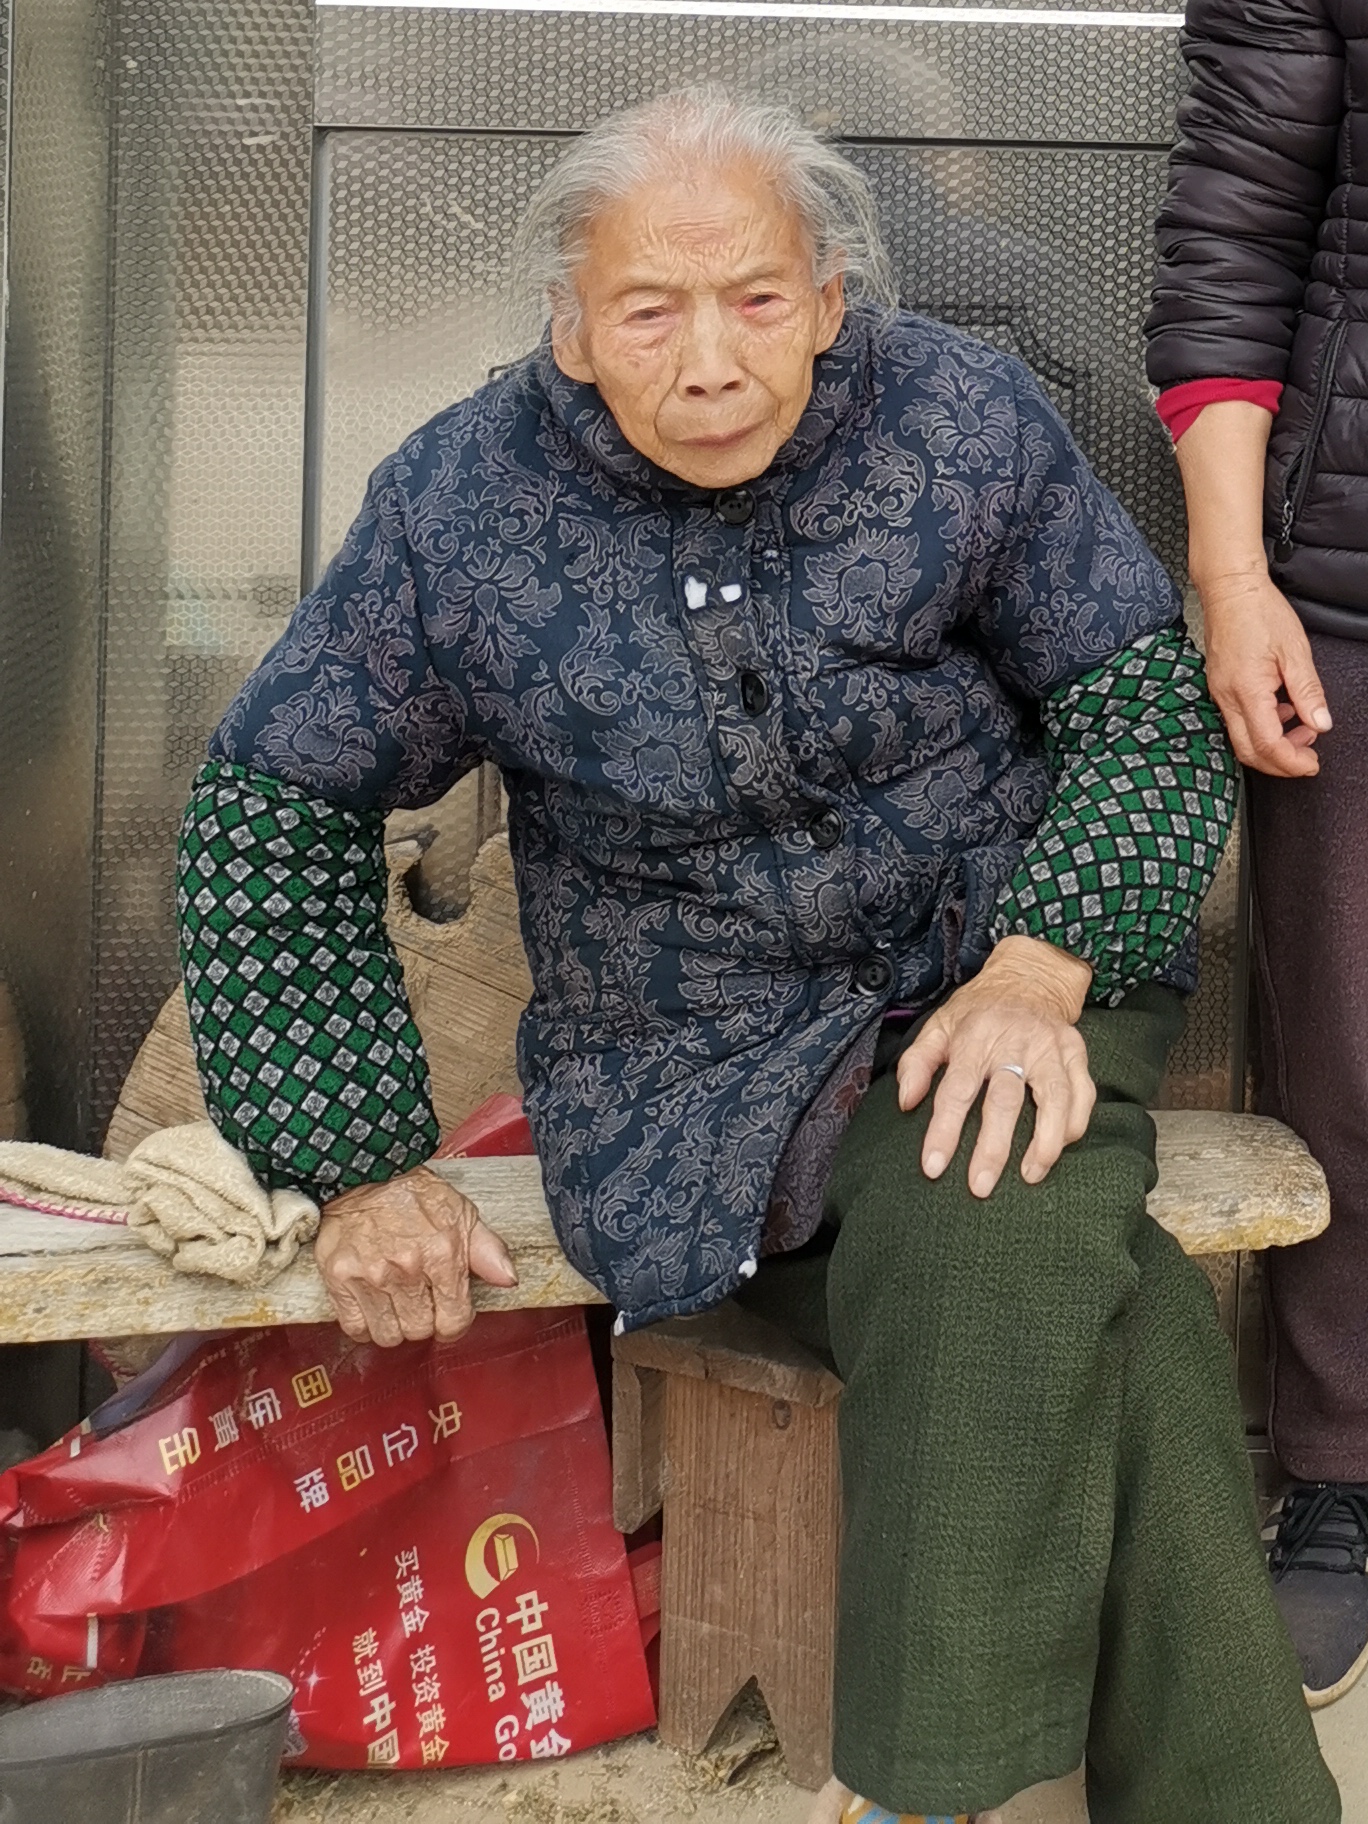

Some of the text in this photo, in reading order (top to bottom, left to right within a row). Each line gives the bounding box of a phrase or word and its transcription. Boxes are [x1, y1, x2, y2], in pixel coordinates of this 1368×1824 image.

[294, 1401, 462, 1513] 央企品牌
[352, 1627, 401, 1766] 就到中国
[395, 1545, 450, 1765] 买黄金 投资黄金
[476, 1608, 523, 1762] China Go
[506, 1590, 571, 1760] 中国黄金
